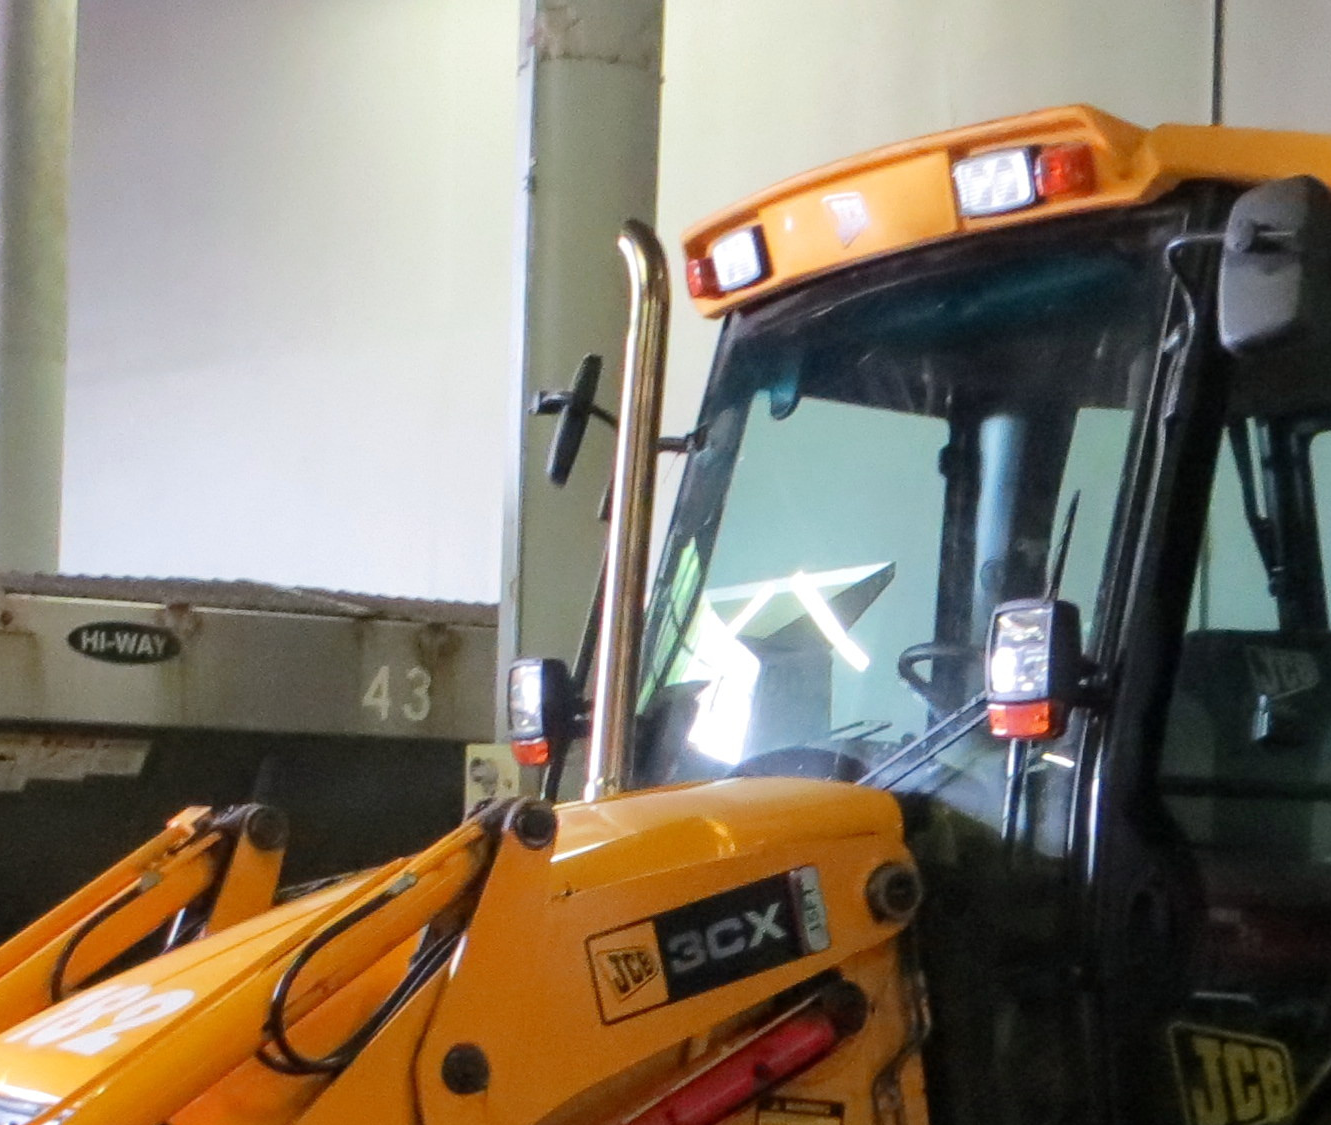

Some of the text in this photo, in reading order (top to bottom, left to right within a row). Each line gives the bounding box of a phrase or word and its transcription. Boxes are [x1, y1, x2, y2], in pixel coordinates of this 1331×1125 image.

[80, 630, 167, 656] HI-WAY
[361, 664, 432, 722] 43
[669, 902, 787, 973] 3CX
[608, 950, 655, 995] JCB
